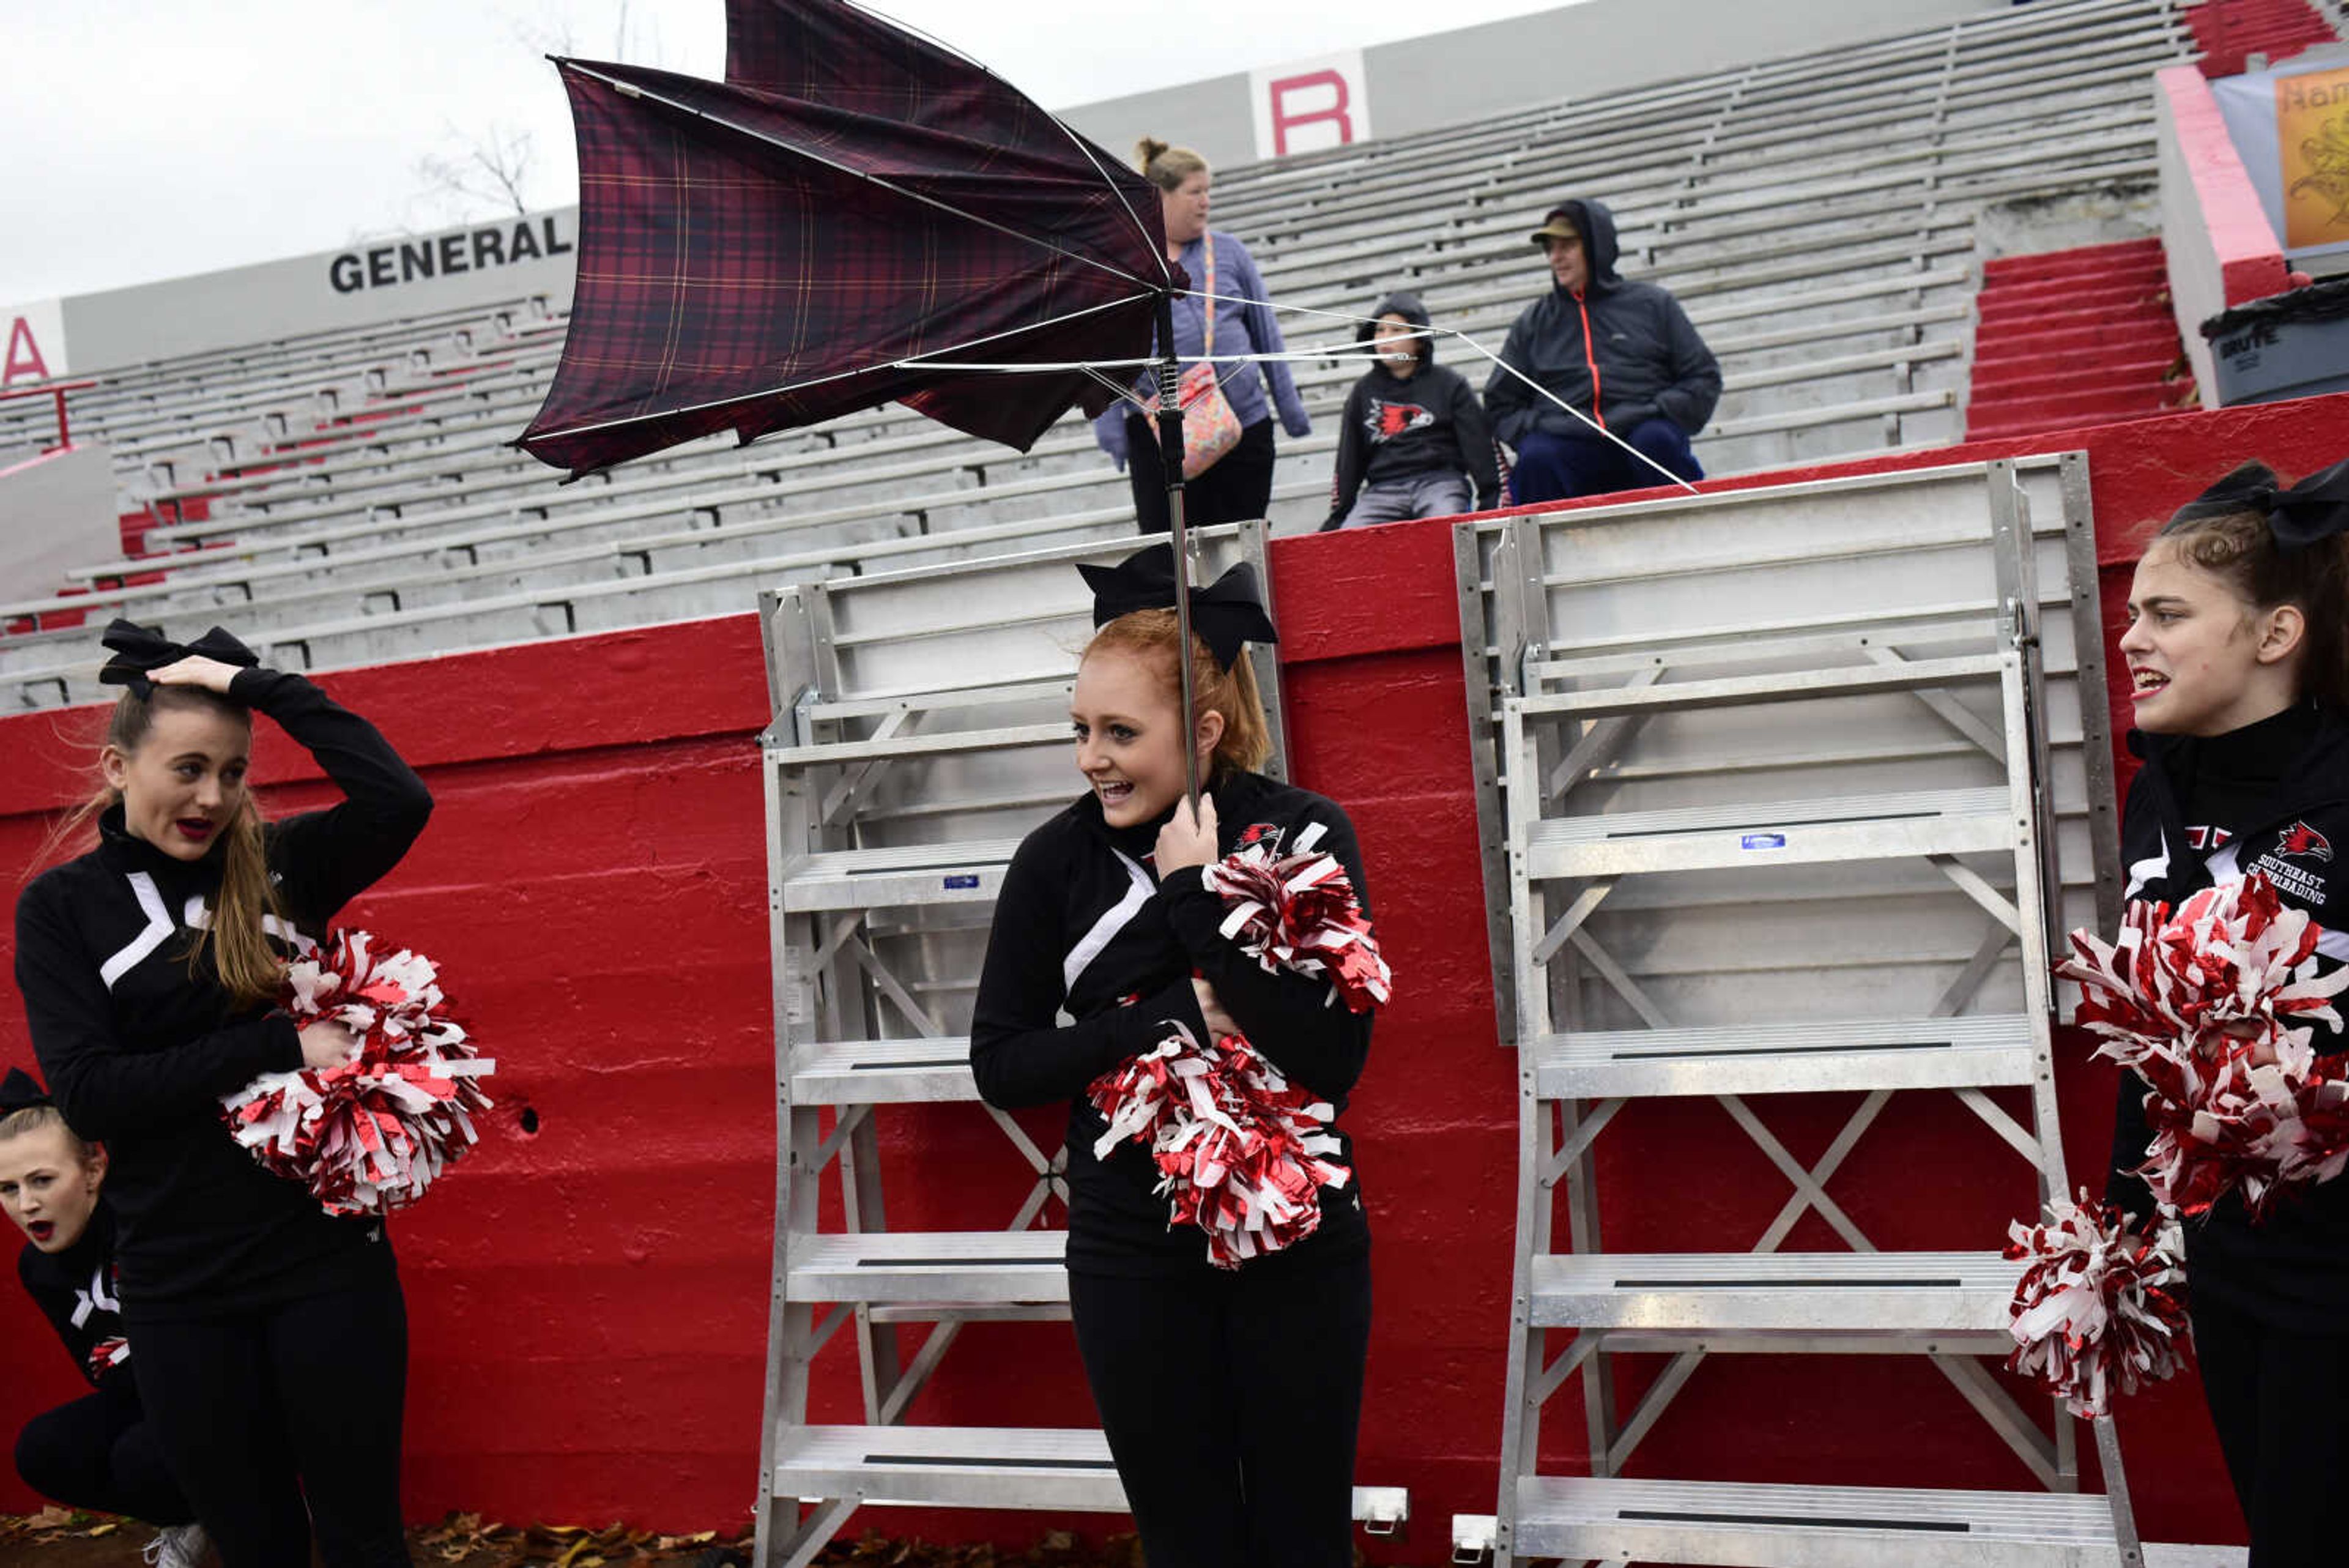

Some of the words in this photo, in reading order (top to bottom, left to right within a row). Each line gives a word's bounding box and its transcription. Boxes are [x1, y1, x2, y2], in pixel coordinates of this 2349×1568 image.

[1269, 69, 1352, 157] R
[330, 217, 572, 294] GENERAL
[2, 316, 50, 386] A
[2258, 854, 2325, 889] SOUTHEAST
